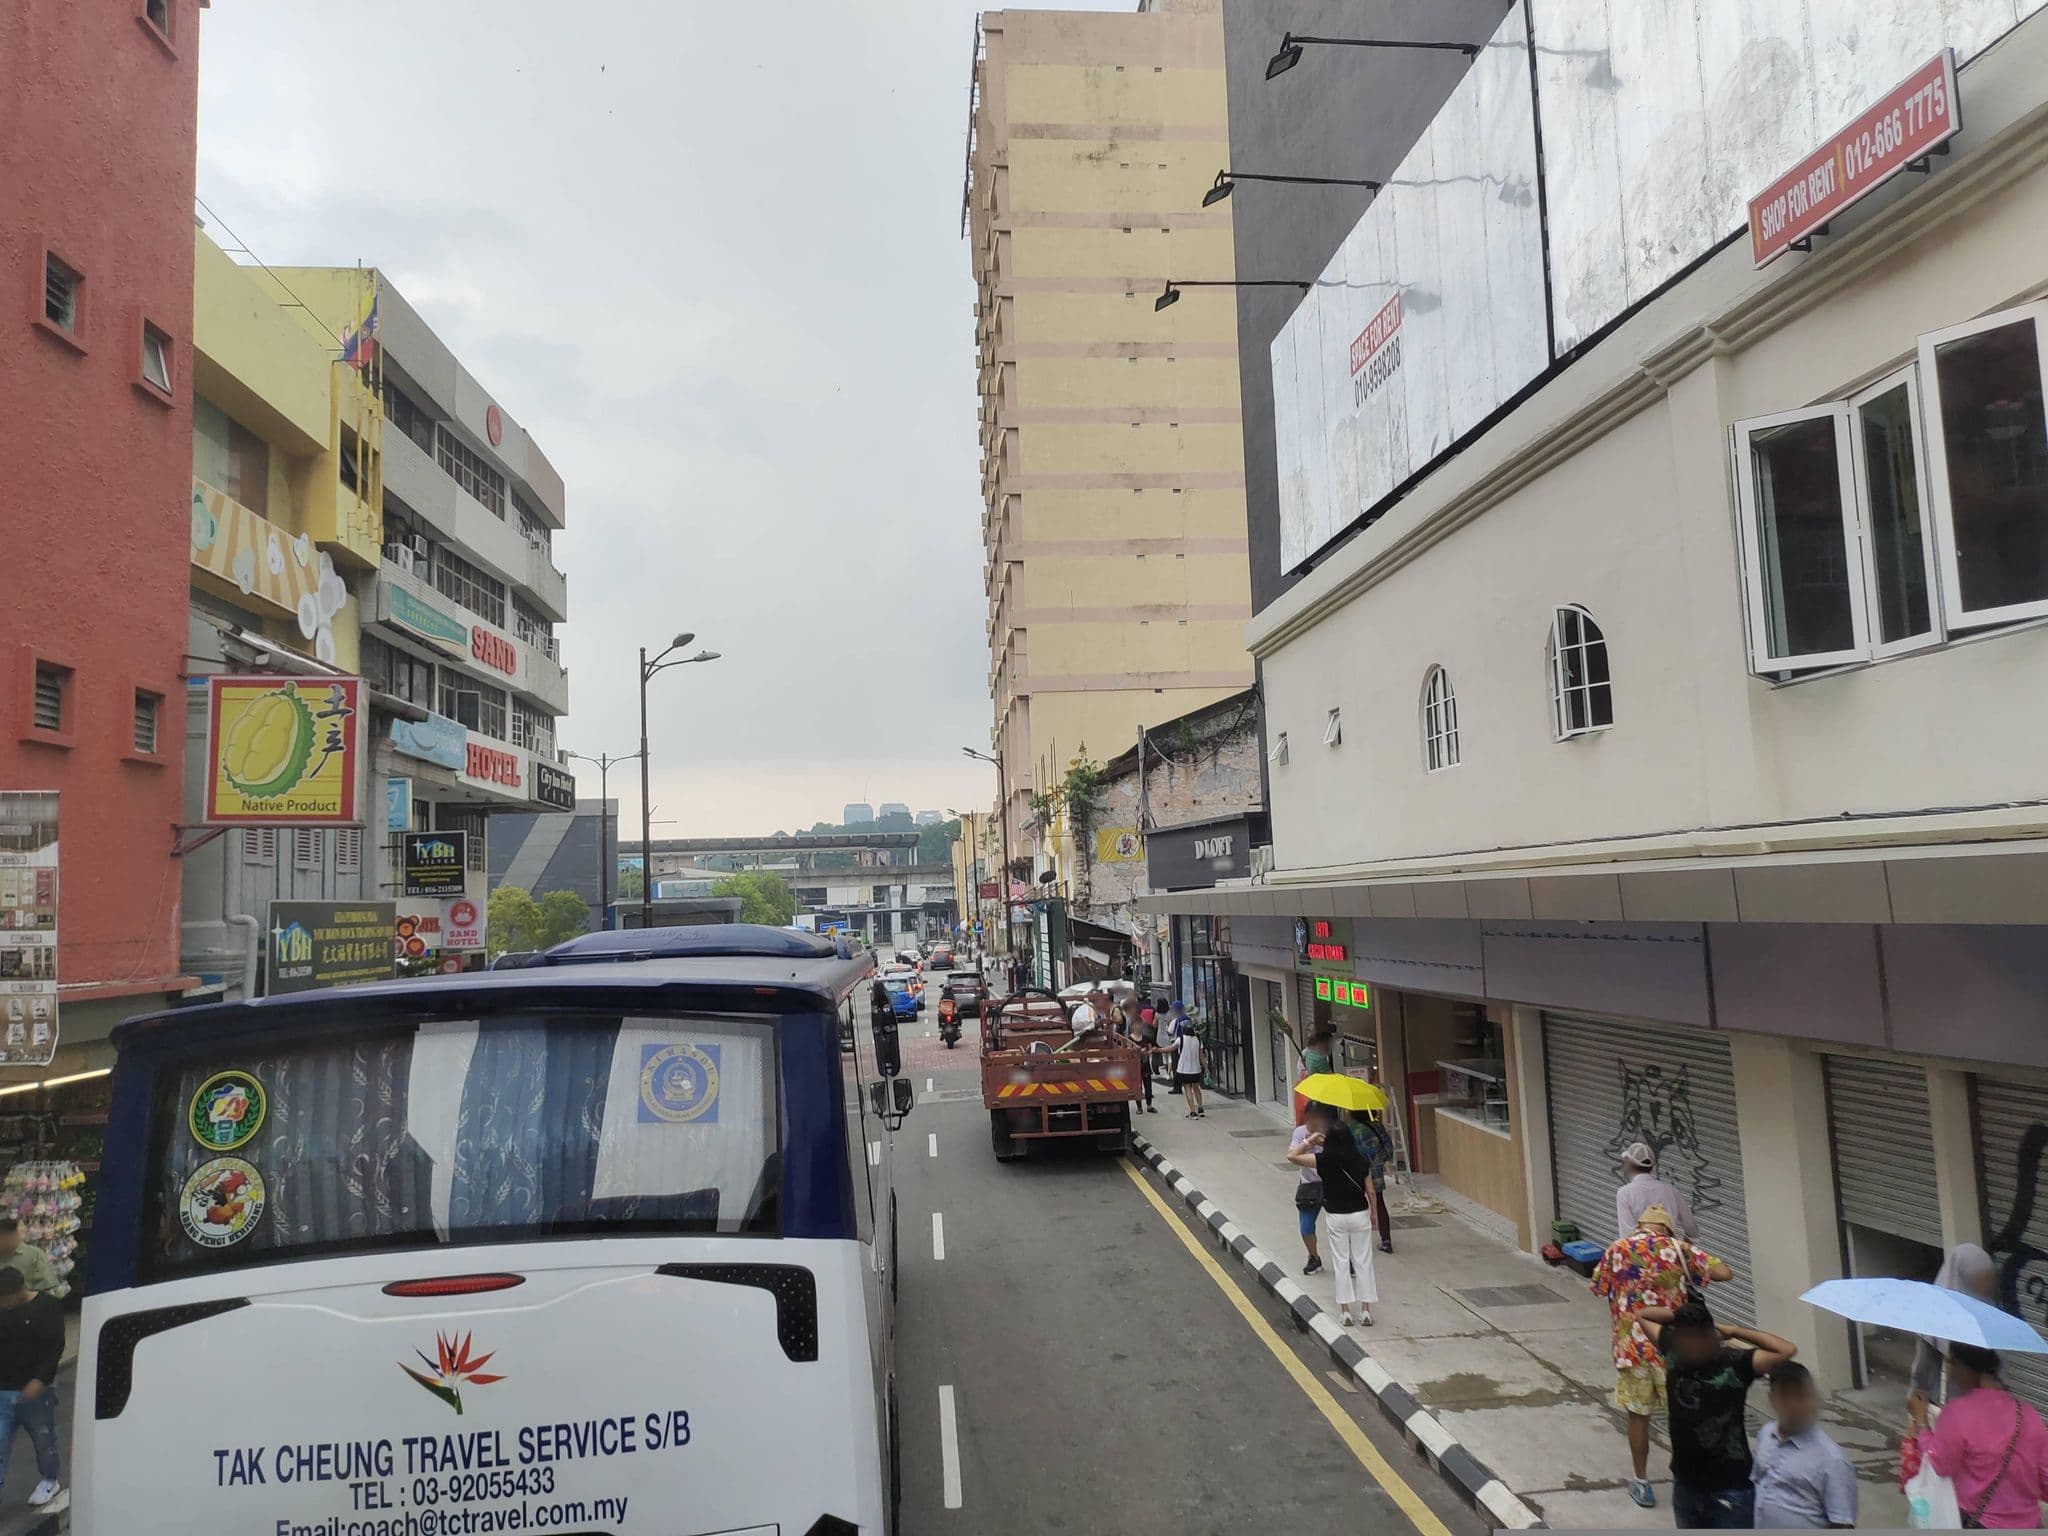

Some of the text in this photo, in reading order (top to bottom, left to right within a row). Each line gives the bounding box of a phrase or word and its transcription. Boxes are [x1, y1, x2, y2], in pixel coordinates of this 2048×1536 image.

[1761, 76, 1945, 241] SHOP FOR RENT 012-666 7775
[1351, 298, 1400, 370] SPACE FOR RENT
[1354, 336, 1401, 408] 010-9598208
[471, 625, 517, 675] SAND
[466, 742, 522, 787] HOTEL
[541, 767, 552, 790] City
[241, 799, 338, 812] Native Product
[420, 841, 456, 859] YBH
[279, 927, 313, 963] YBH
[446, 938, 480, 947] HOTEL
[449, 930, 478, 938] SAND
[181, 1202, 263, 1247] ABANG PERGI BERJUANG
[213, 1410, 691, 1487] TAK CHEUNG TRAVEL SERVICE S/B
[349, 1481, 393, 1511] TEL
[413, 1466, 555, 1507] 03-92055433
[276, 1496, 628, 1536] Email:coach@tctravel.com.my
